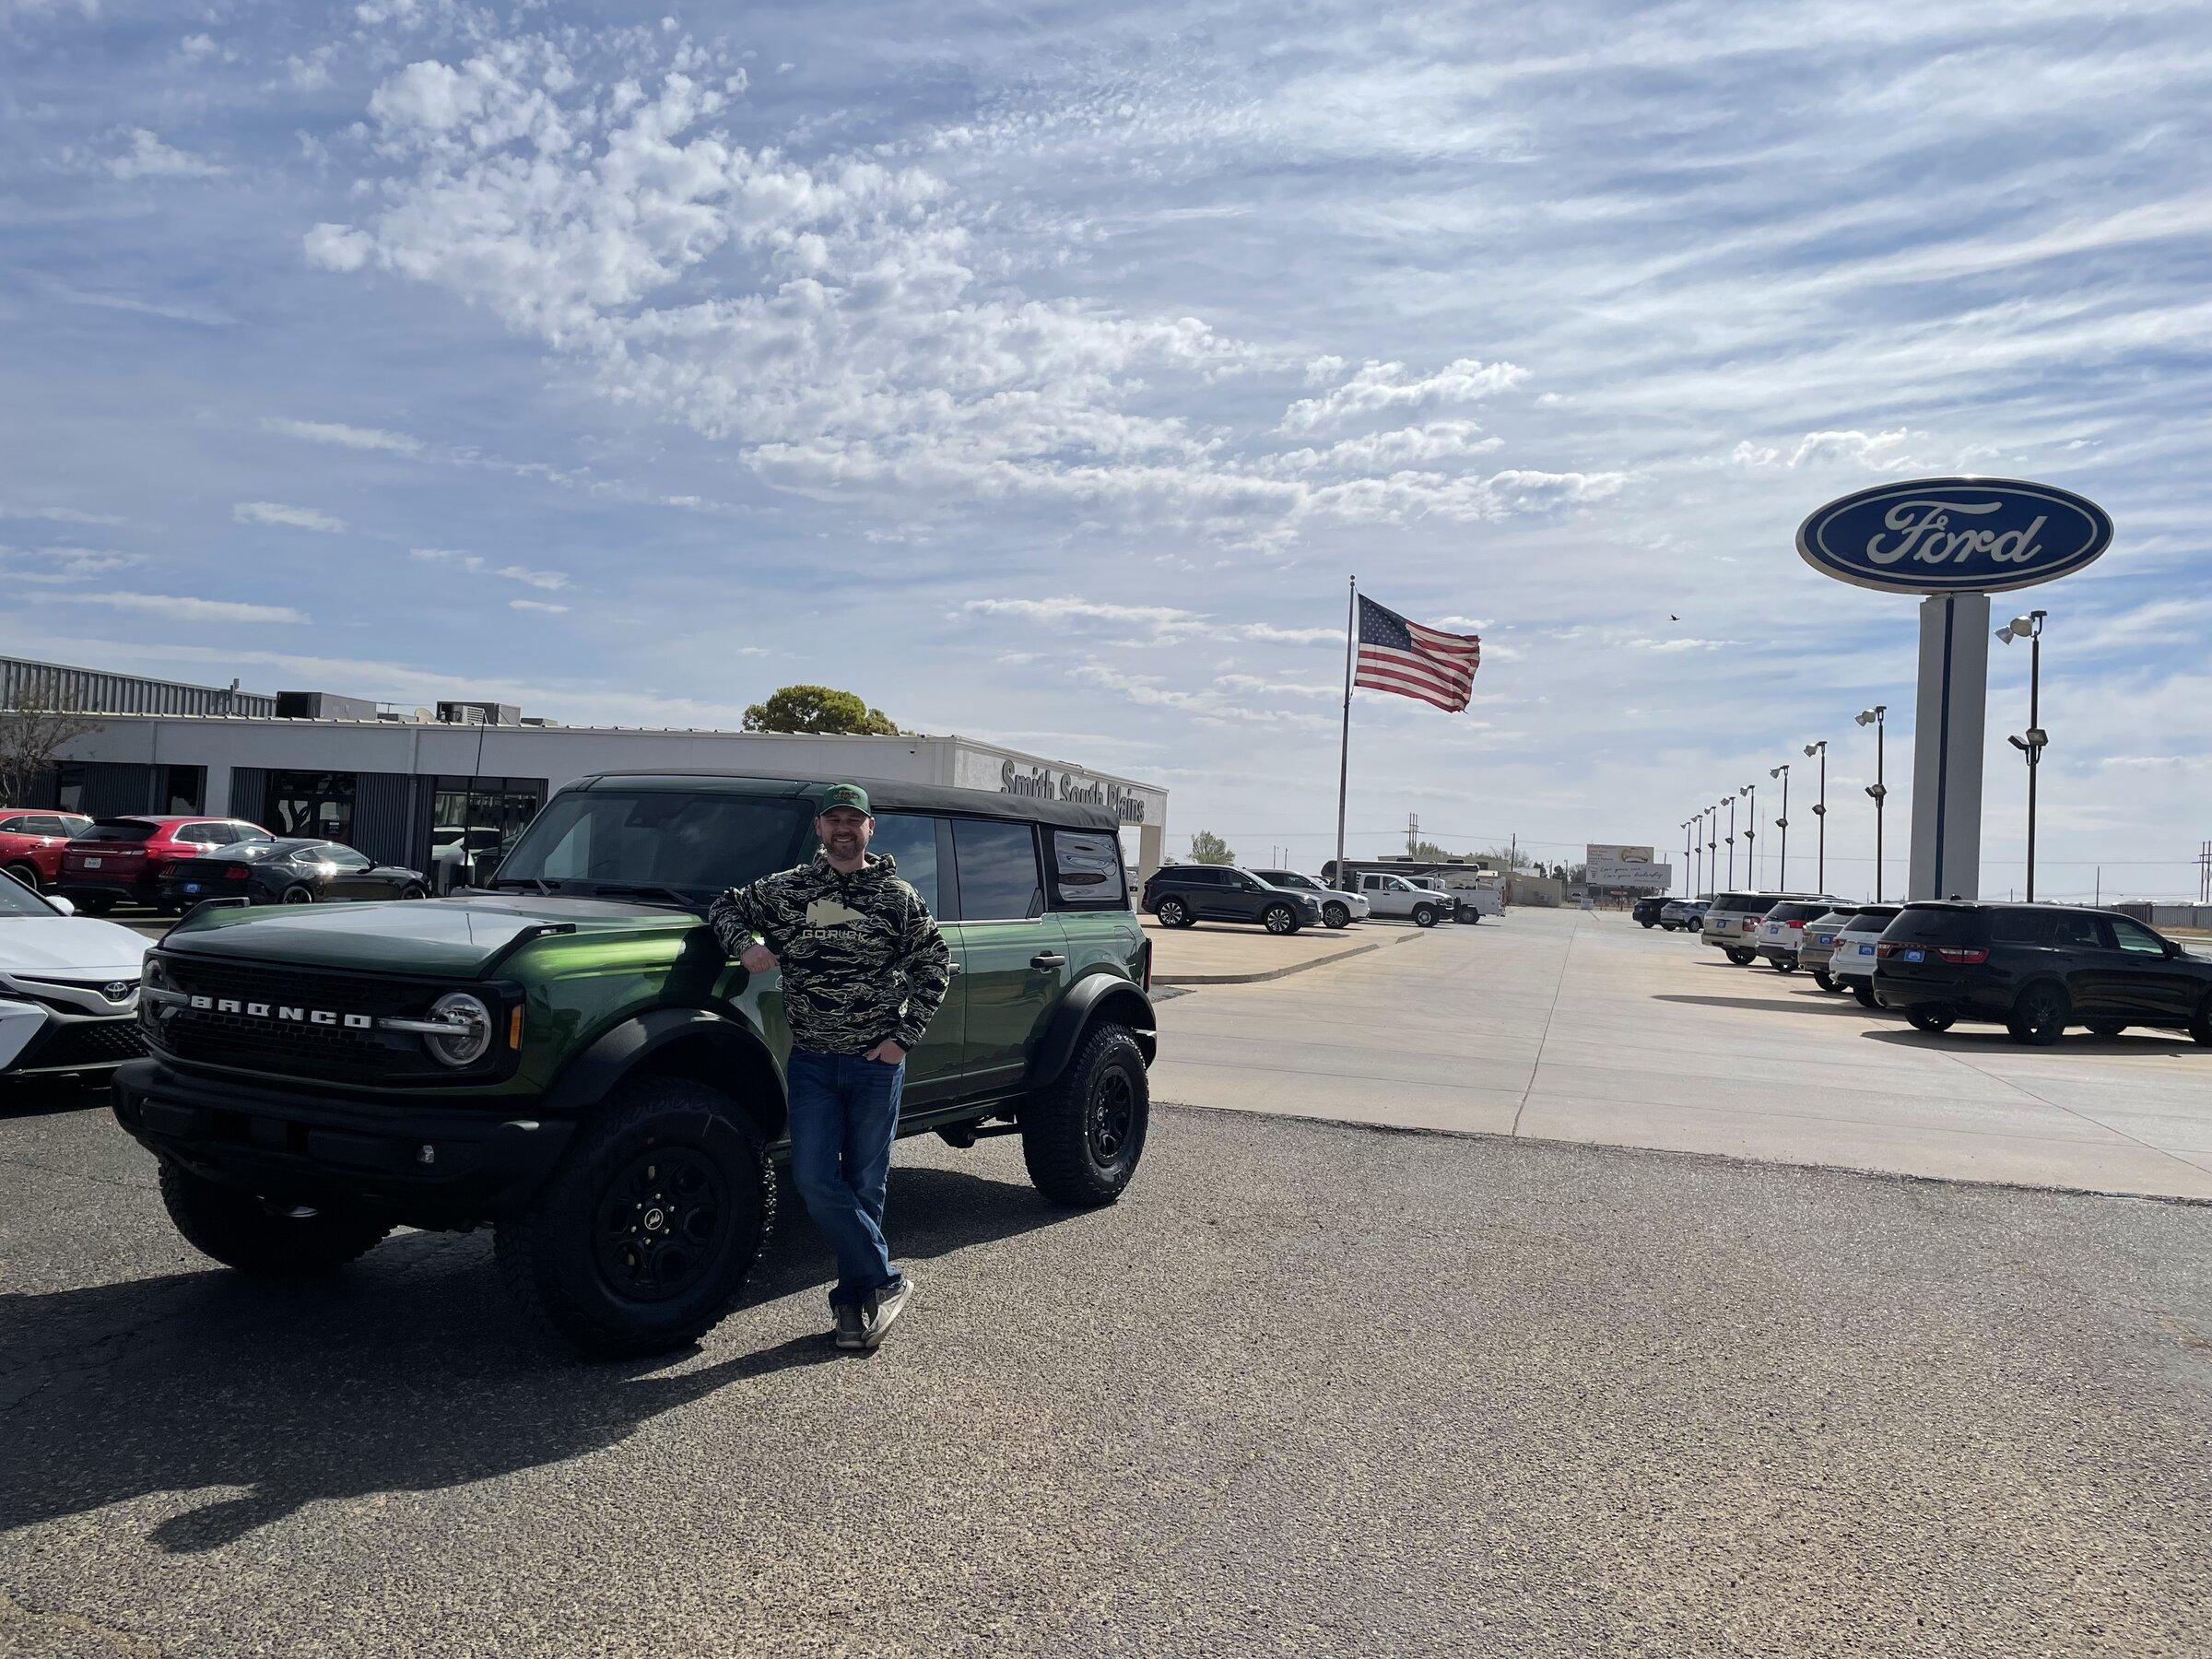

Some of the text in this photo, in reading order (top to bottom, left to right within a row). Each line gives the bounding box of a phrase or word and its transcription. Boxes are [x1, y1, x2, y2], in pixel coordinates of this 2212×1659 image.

[1865, 500, 2048, 565] Ford
[1001, 759, 1145, 822] Smith South Plains
[190, 995, 372, 1029] BRONCO
